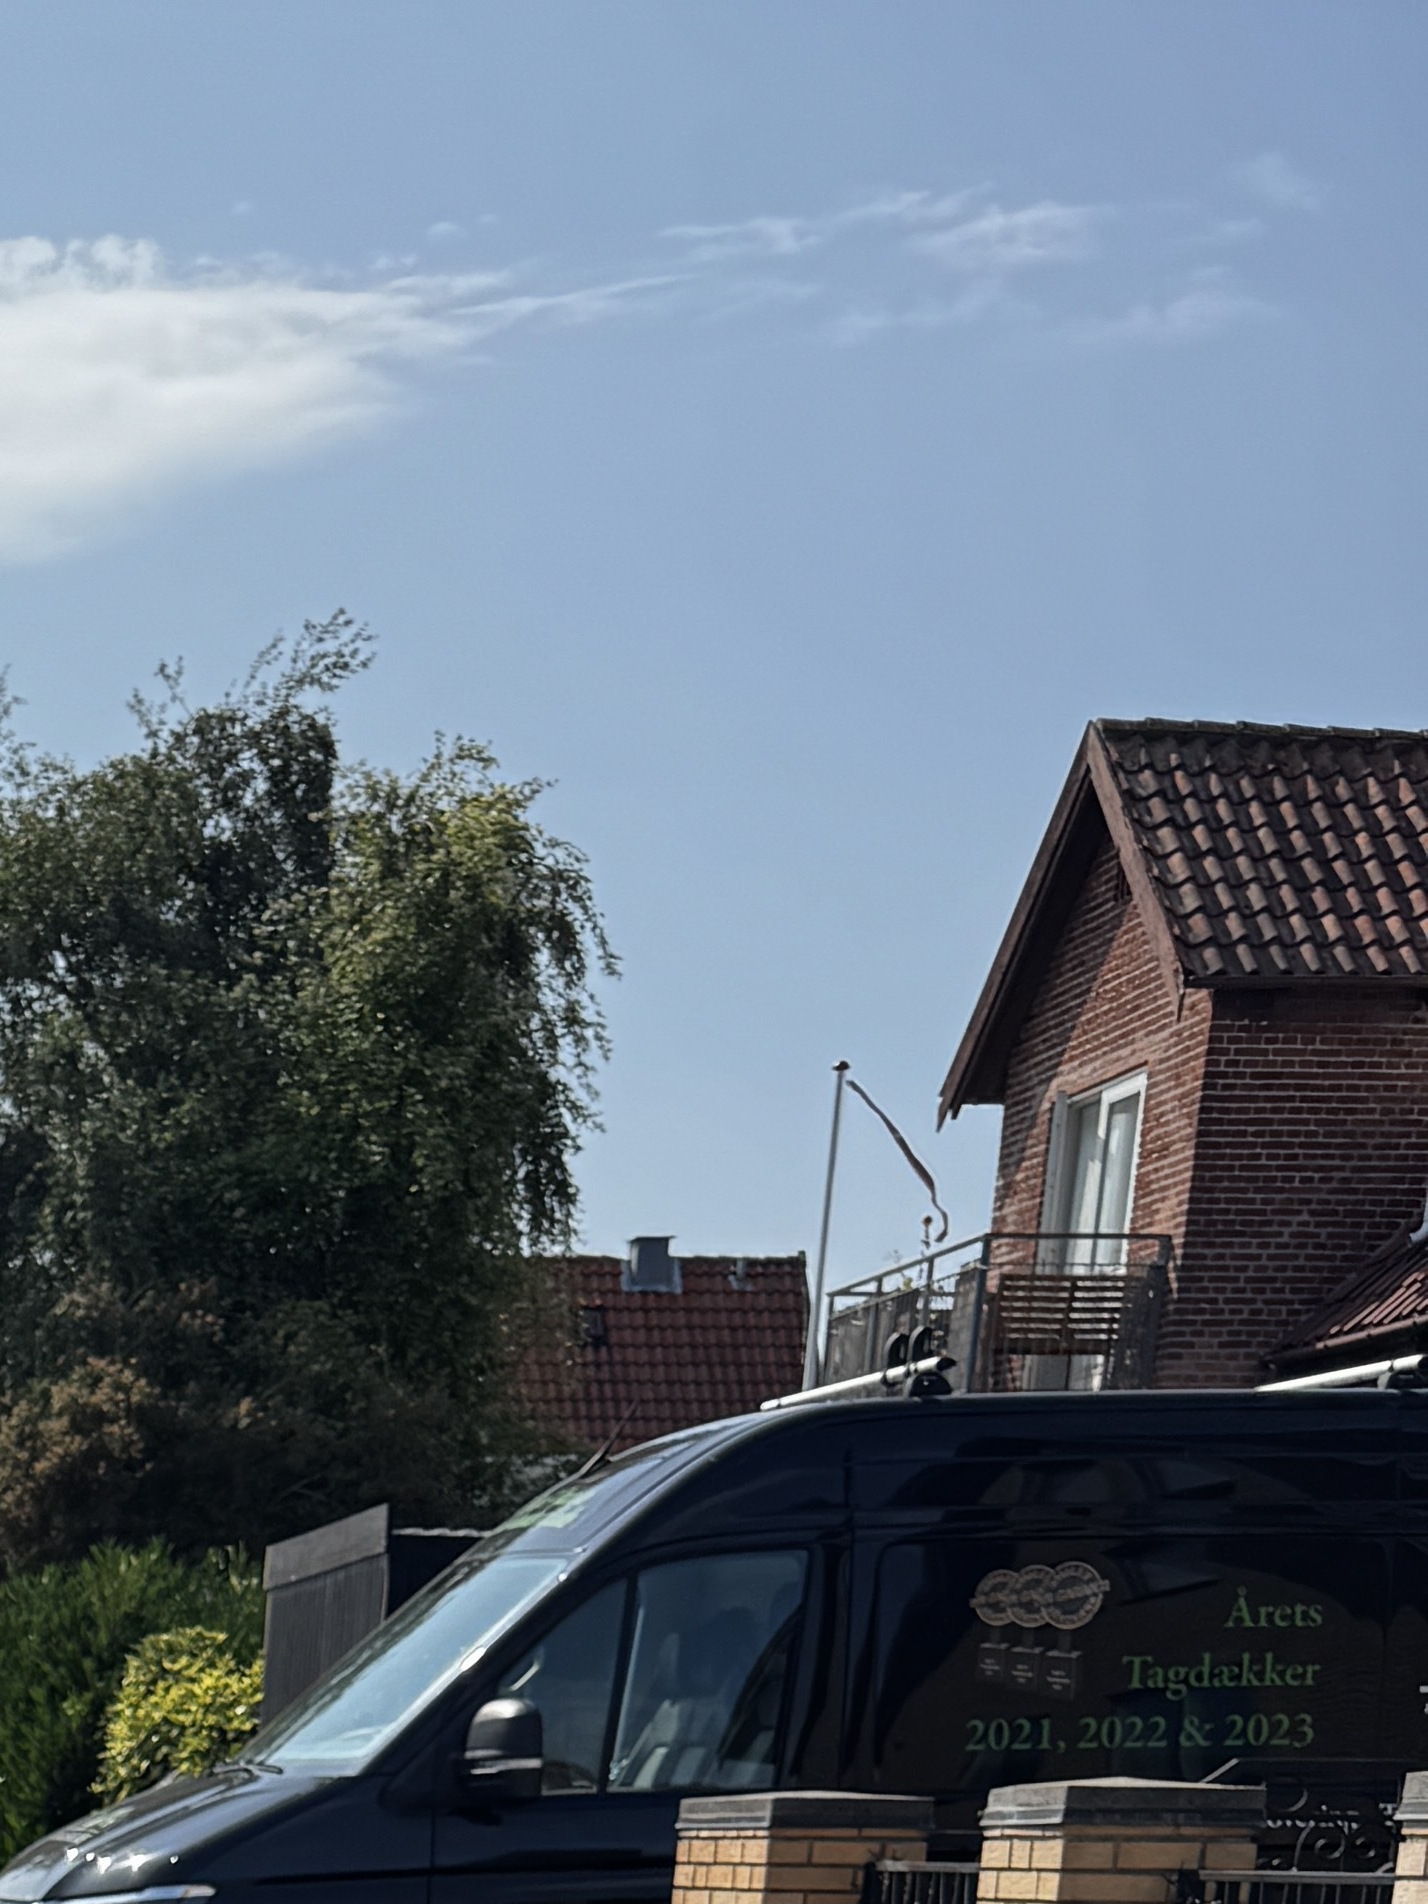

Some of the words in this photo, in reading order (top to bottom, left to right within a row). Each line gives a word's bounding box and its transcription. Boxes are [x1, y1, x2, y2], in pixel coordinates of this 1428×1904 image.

[1223, 1585, 1324, 1628] Årets
[1121, 1651, 1322, 1700] Tagdækker
[964, 1717, 1067, 1753] 2021,
[1076, 1715, 1168, 1749] 2022
[1177, 1715, 1215, 1748] &
[1222, 1712, 1315, 1749] 2023
